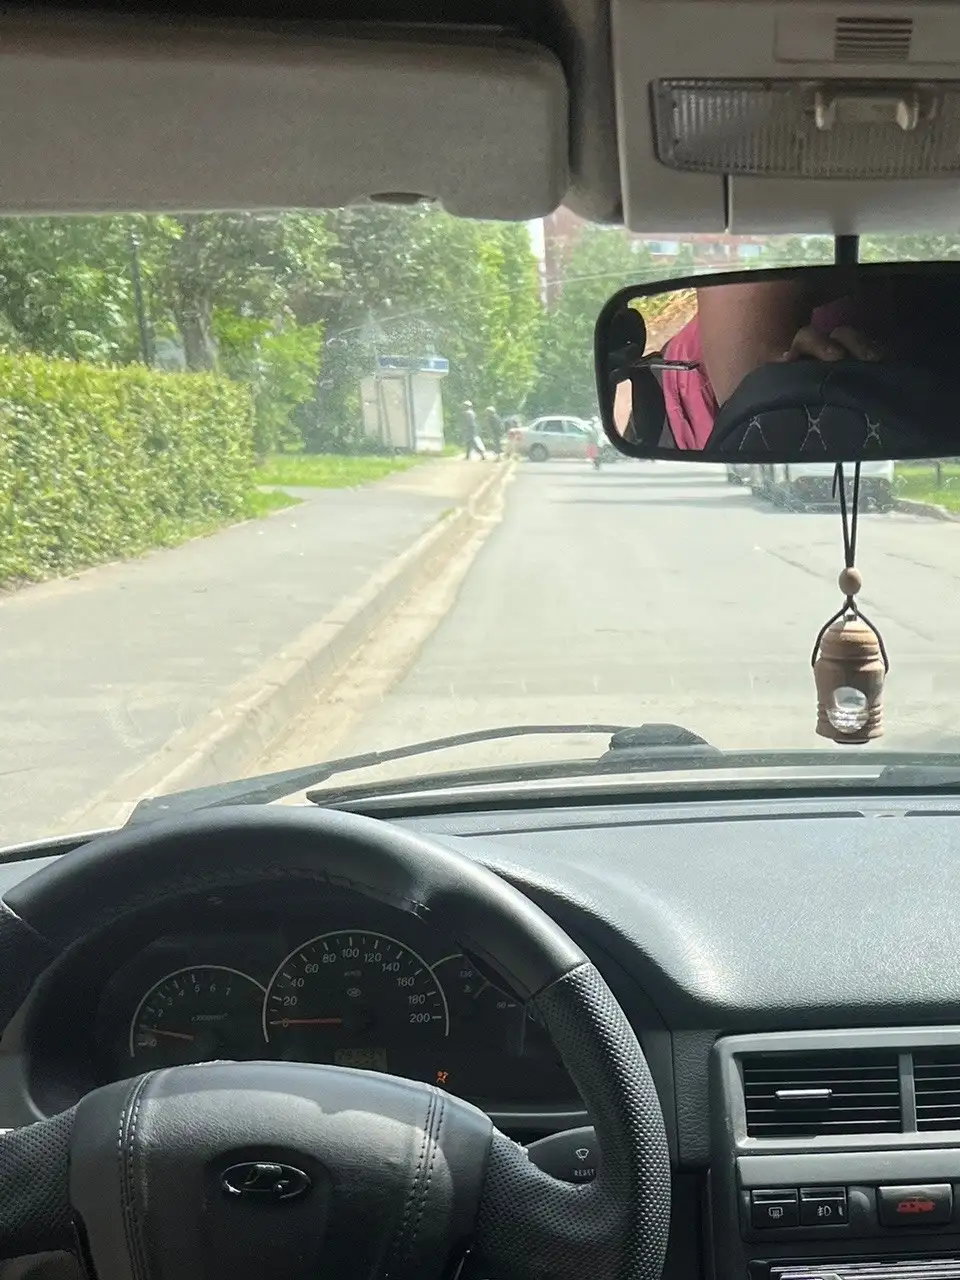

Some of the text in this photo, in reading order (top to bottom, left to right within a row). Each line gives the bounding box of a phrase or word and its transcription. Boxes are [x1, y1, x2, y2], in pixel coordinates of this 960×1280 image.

[322, 953, 337, 963] 80
[342, 948, 360, 958] 100
[363, 952, 382, 963] 120
[304, 963, 319, 973] 60
[382, 962, 400, 972] 140
[290, 977, 305, 988] 40
[396, 976, 415, 987] 160
[283, 995, 298, 1006] 20
[407, 994, 426, 1004] 180
[409, 1013, 430, 1023] 200
